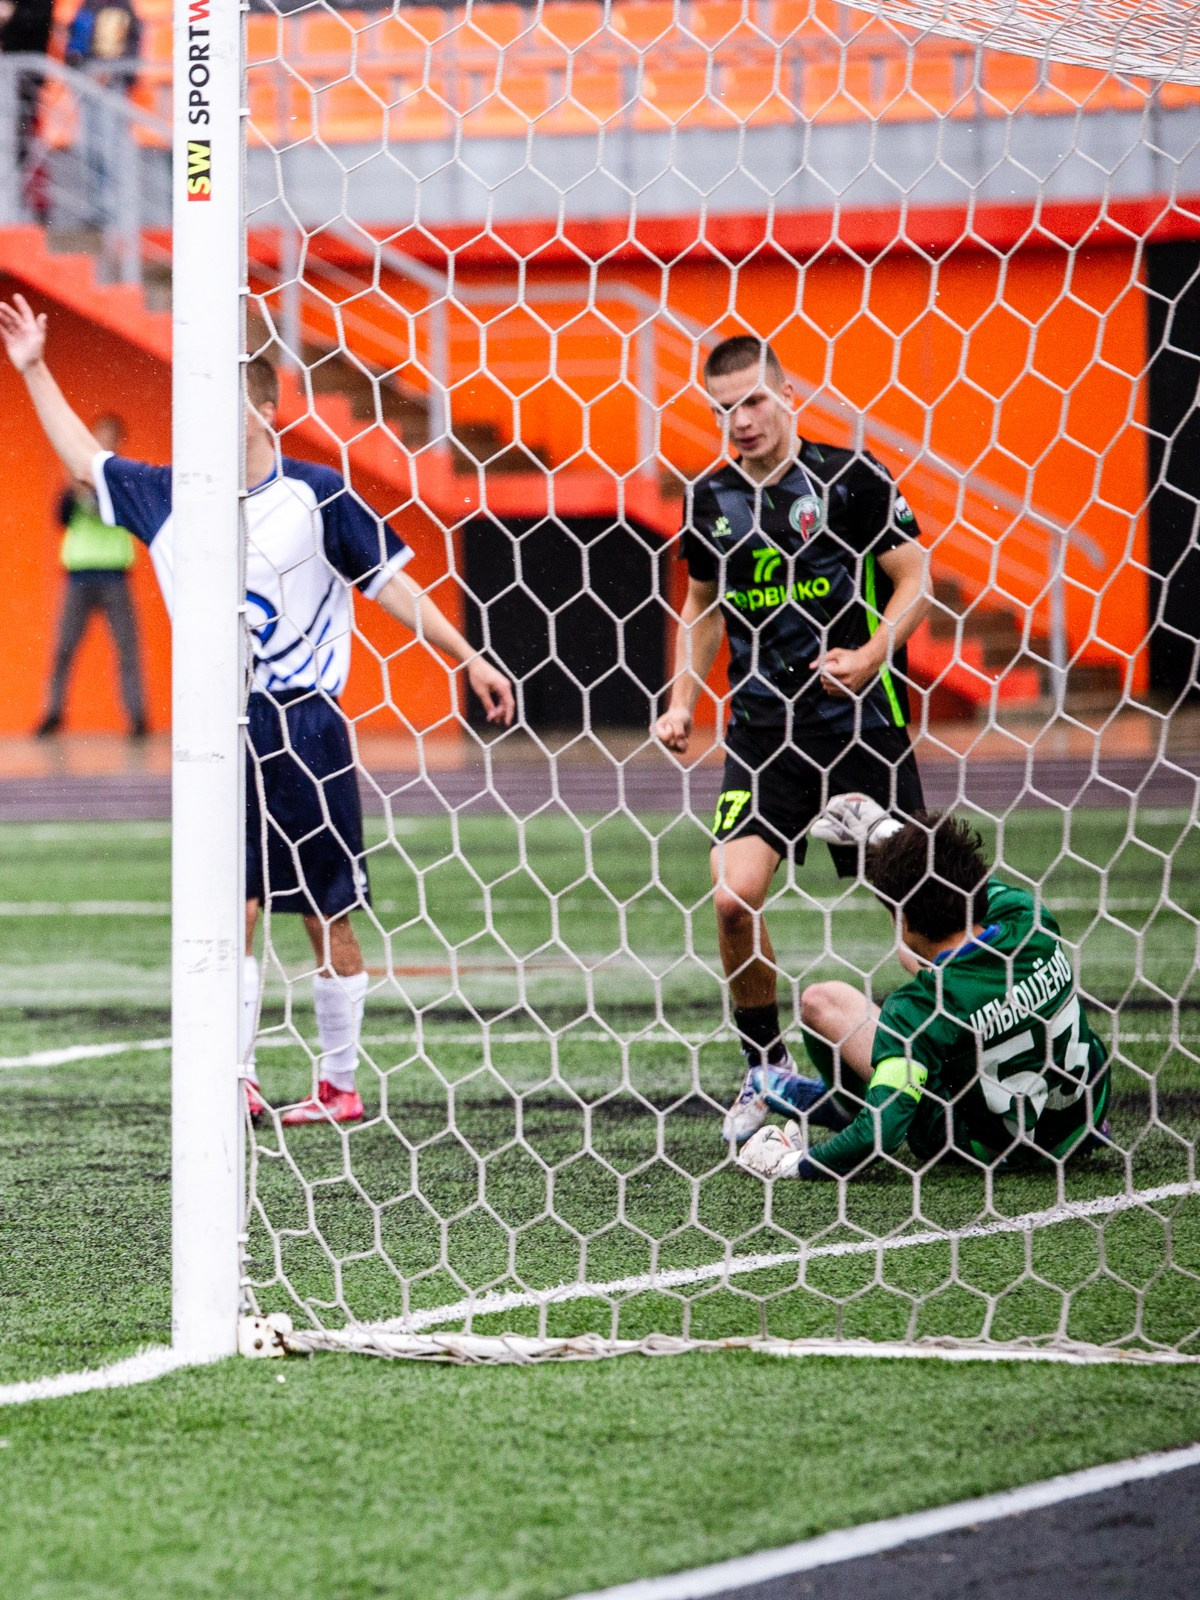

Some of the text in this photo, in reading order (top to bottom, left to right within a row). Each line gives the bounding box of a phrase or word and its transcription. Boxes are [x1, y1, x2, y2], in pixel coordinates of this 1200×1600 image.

[188, 139, 211, 195] SW
[969, 941, 1072, 1042] ИЛЬЮШЁНО
[979, 994, 1090, 1143] 53
